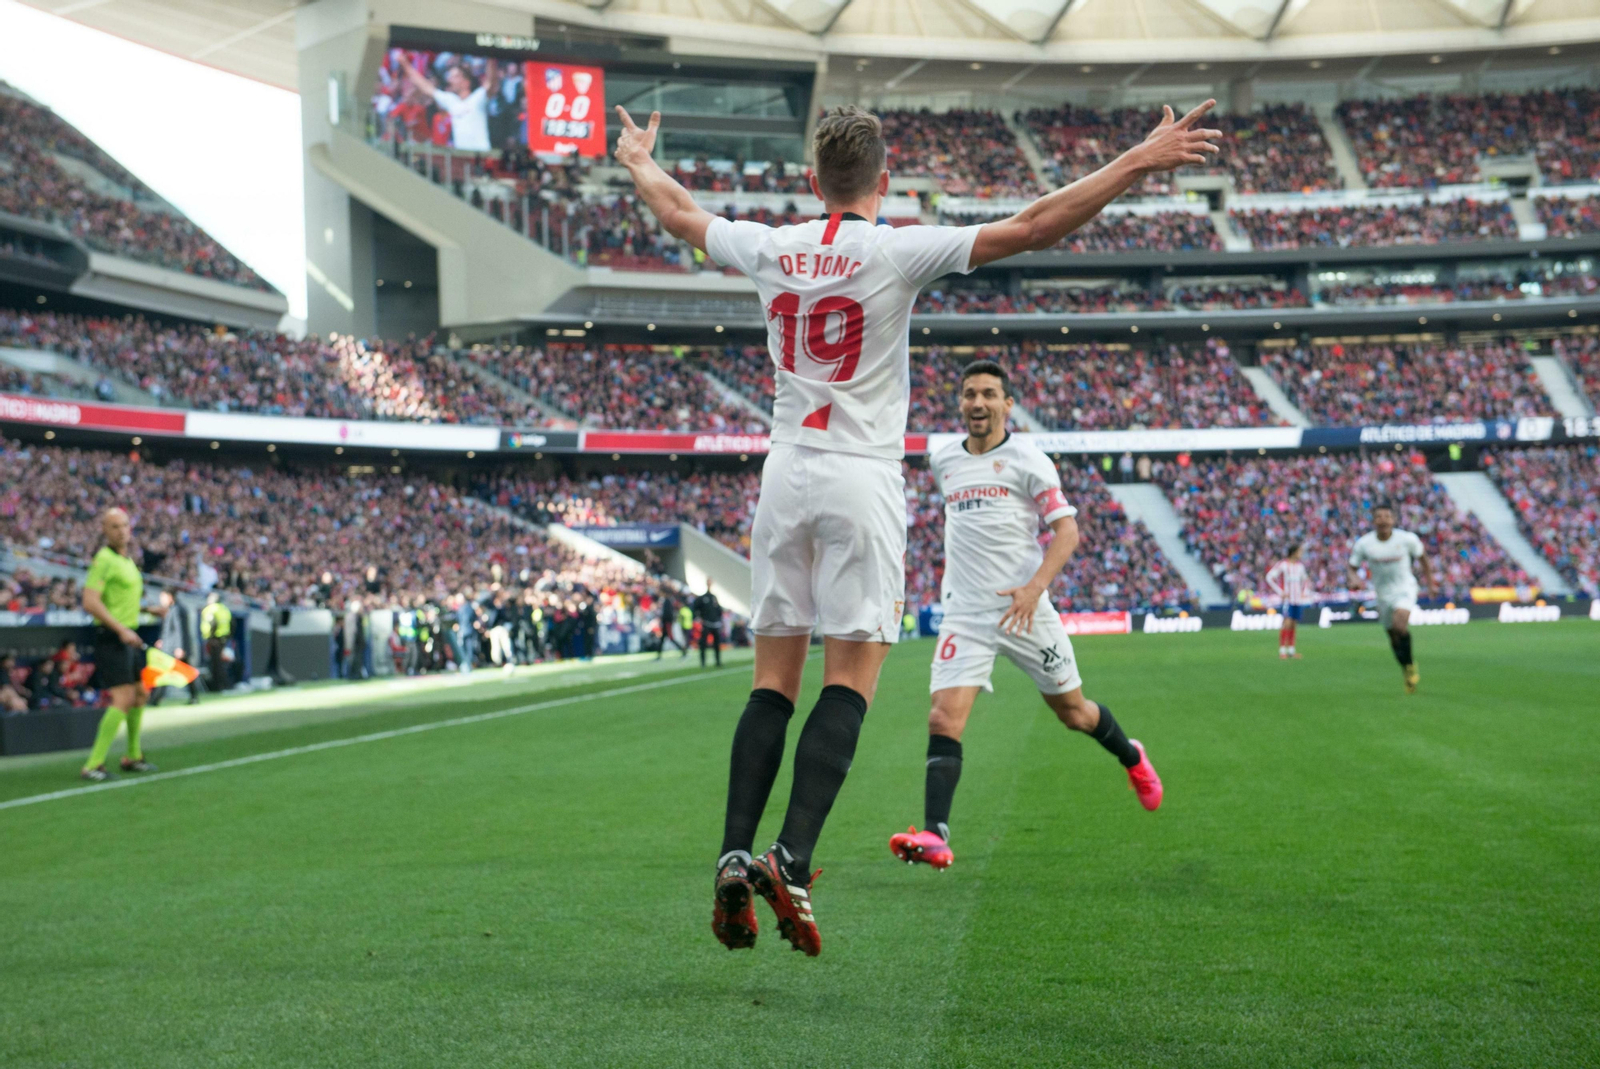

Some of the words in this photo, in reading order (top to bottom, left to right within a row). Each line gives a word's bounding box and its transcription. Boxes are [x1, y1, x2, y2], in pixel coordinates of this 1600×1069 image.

[778, 253, 807, 276] DE
[767, 291, 864, 383] 19
[1359, 422, 1416, 443] ATLÉTICO
[1434, 422, 1487, 441] MADRID
[958, 499, 983, 511] BET
[1498, 601, 1561, 623] bwin
[1143, 613, 1203, 634] bwin
